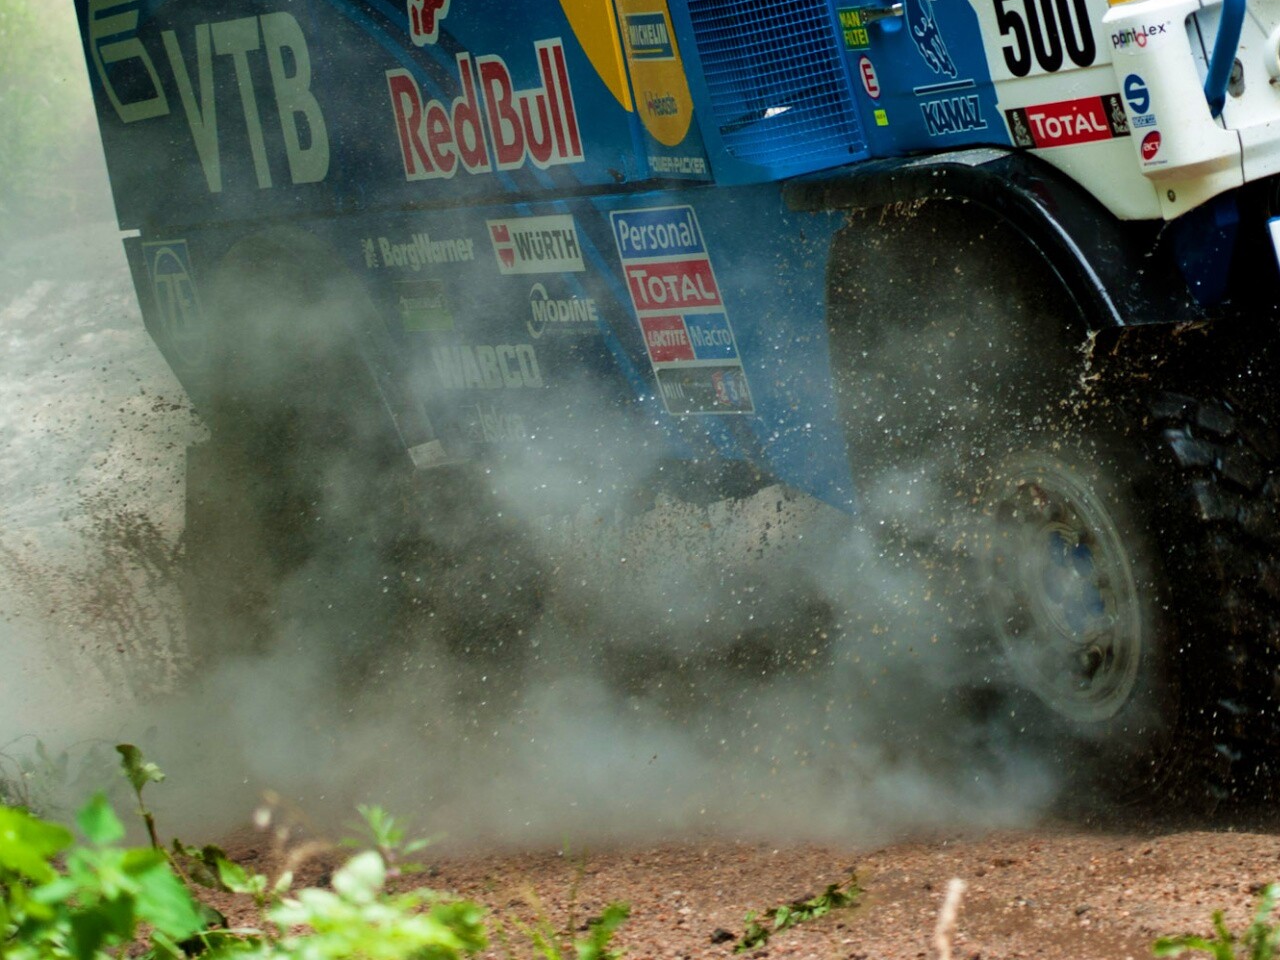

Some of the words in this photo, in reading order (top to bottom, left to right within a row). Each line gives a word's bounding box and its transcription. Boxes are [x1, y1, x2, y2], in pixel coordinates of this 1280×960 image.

[629, 23, 669, 46] MICHELIN
[861, 63, 878, 92] E
[161, 11, 331, 193] VTB
[387, 53, 488, 181] Red
[478, 39, 584, 170] Bull
[919, 95, 988, 137] KAMAZ
[1029, 111, 1108, 139] TOTAL
[512, 228, 580, 262] WÜRTH
[618, 211, 698, 252] Personal
[378, 233, 476, 272] BorgWarner
[629, 269, 716, 304] TOTAL
[531, 297, 598, 323] MODINE
[432, 343, 544, 389] WABCO
